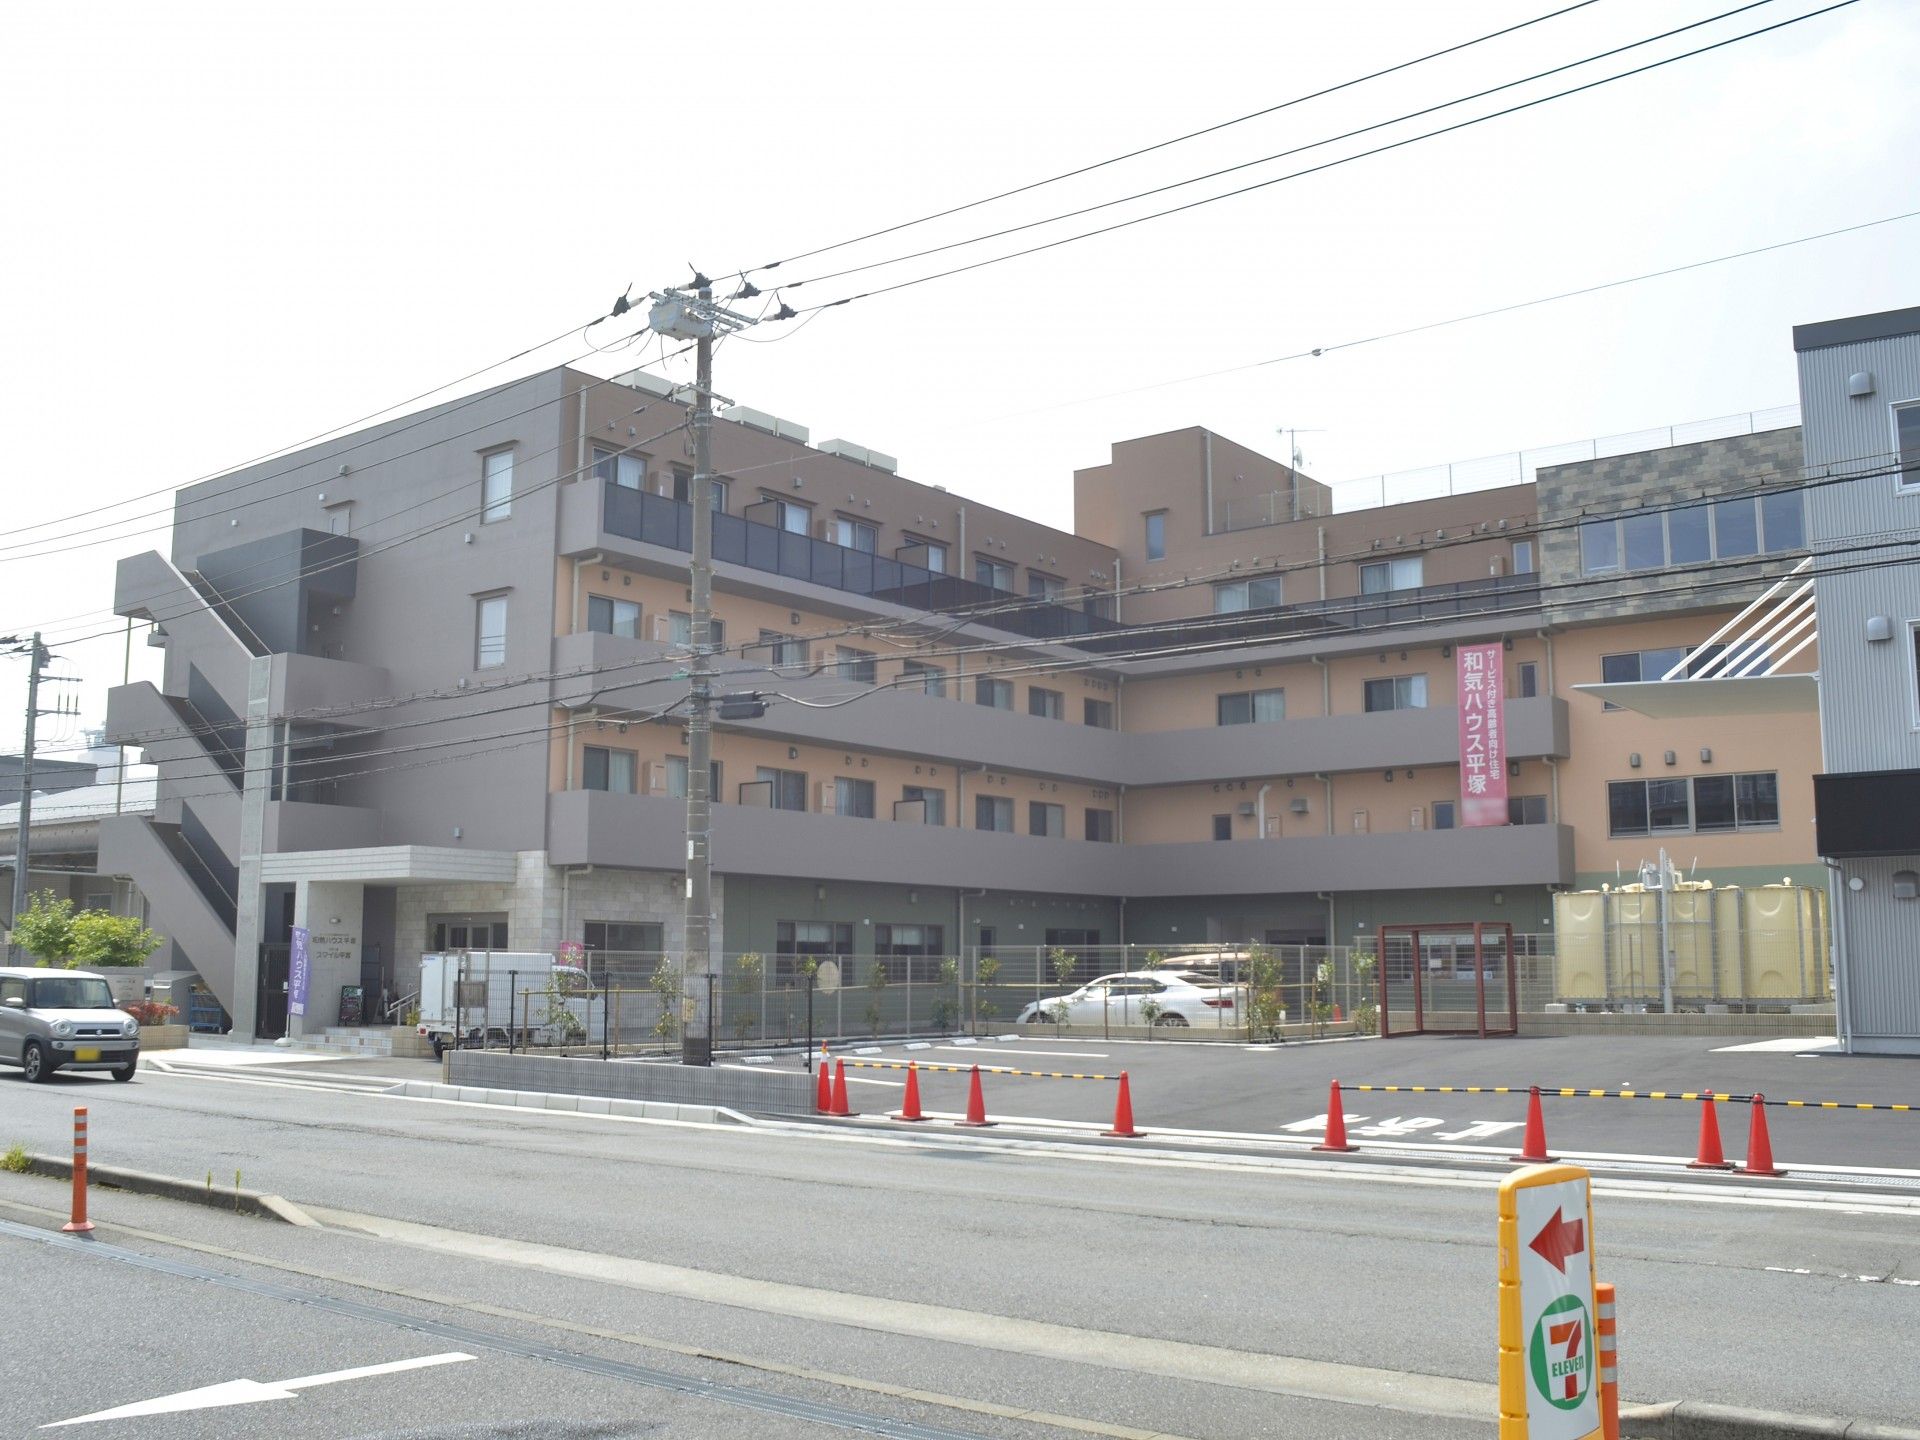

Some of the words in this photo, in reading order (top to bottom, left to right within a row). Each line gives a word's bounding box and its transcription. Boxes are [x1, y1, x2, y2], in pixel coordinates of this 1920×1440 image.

[1464, 652, 1486, 794] 和気ハウス平塚
[1549, 1320, 1582, 1400] 7
